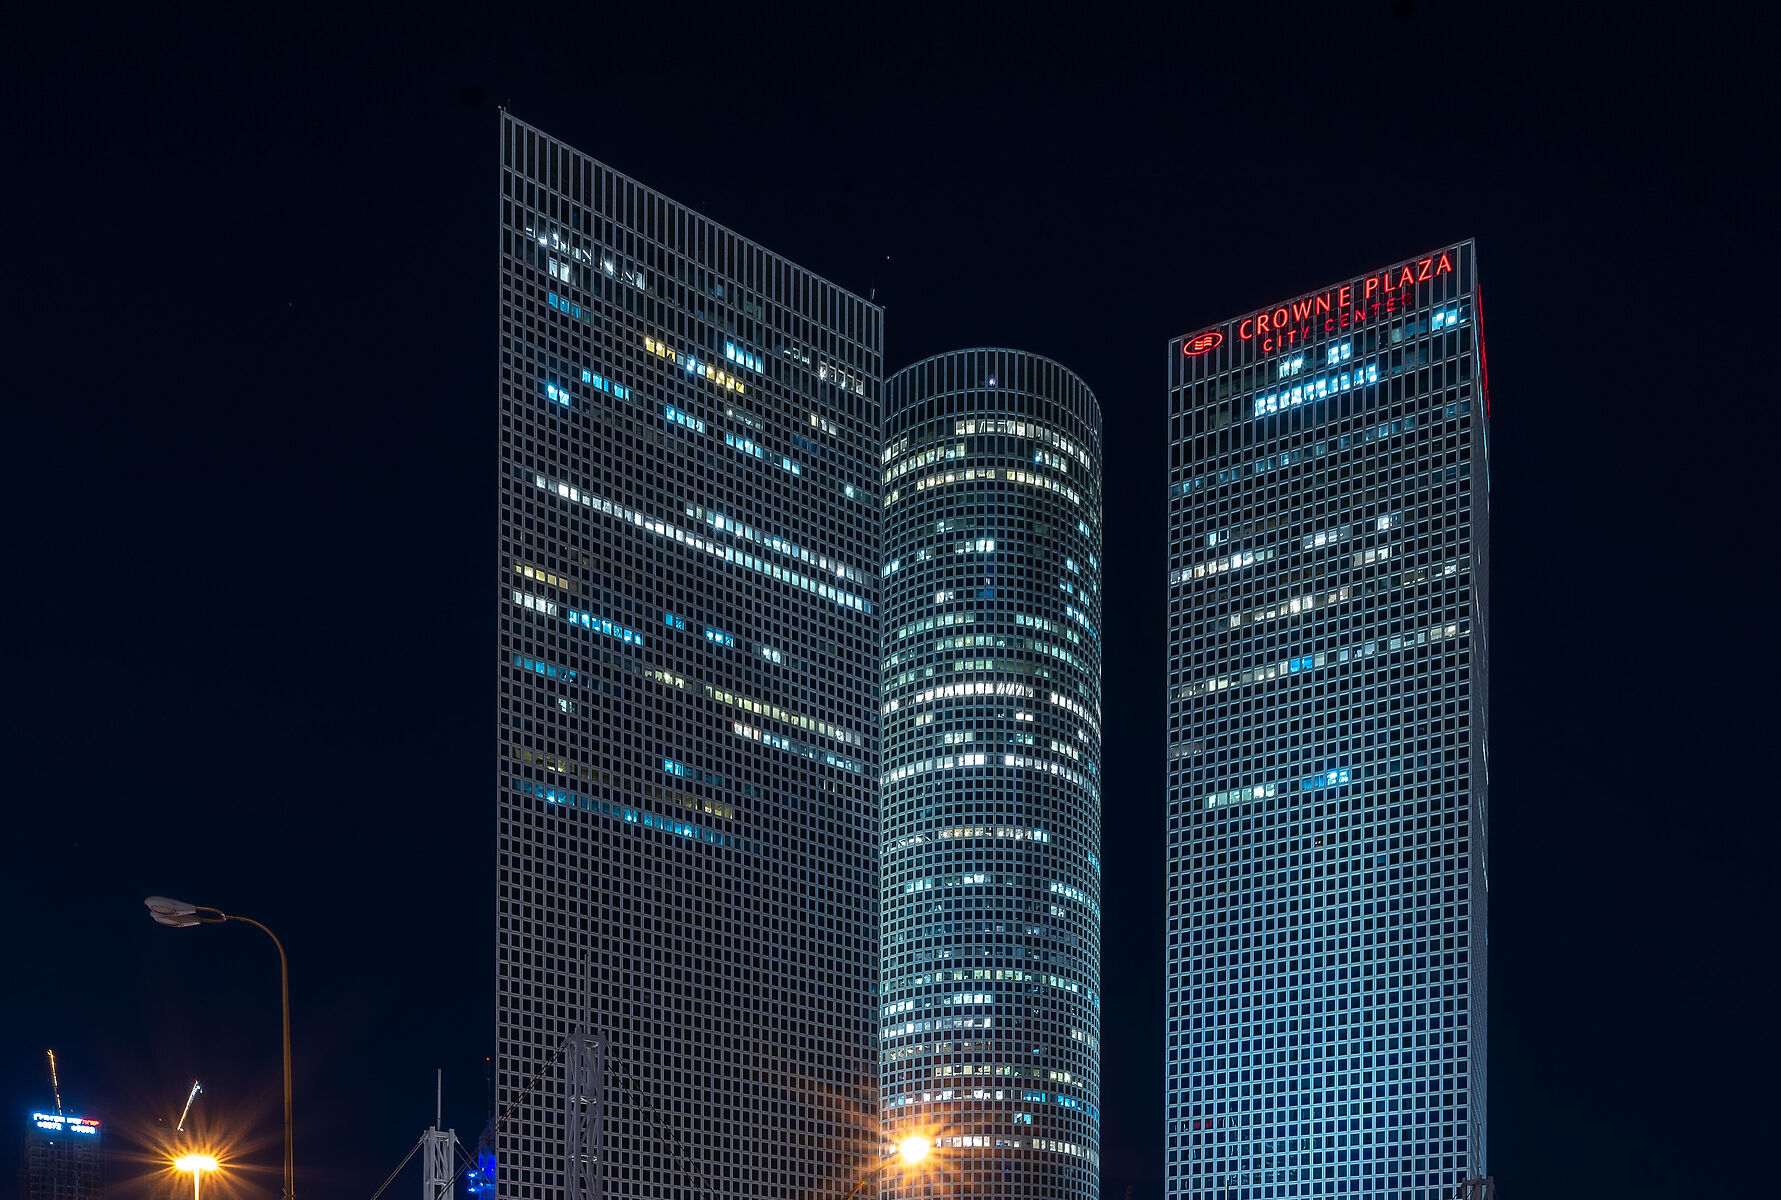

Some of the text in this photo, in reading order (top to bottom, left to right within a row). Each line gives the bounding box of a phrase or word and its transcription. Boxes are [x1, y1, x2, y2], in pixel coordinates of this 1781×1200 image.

[1239, 254, 1452, 340] CROWNE PLAZA
[1263, 293, 1412, 352] CITY CENTER
